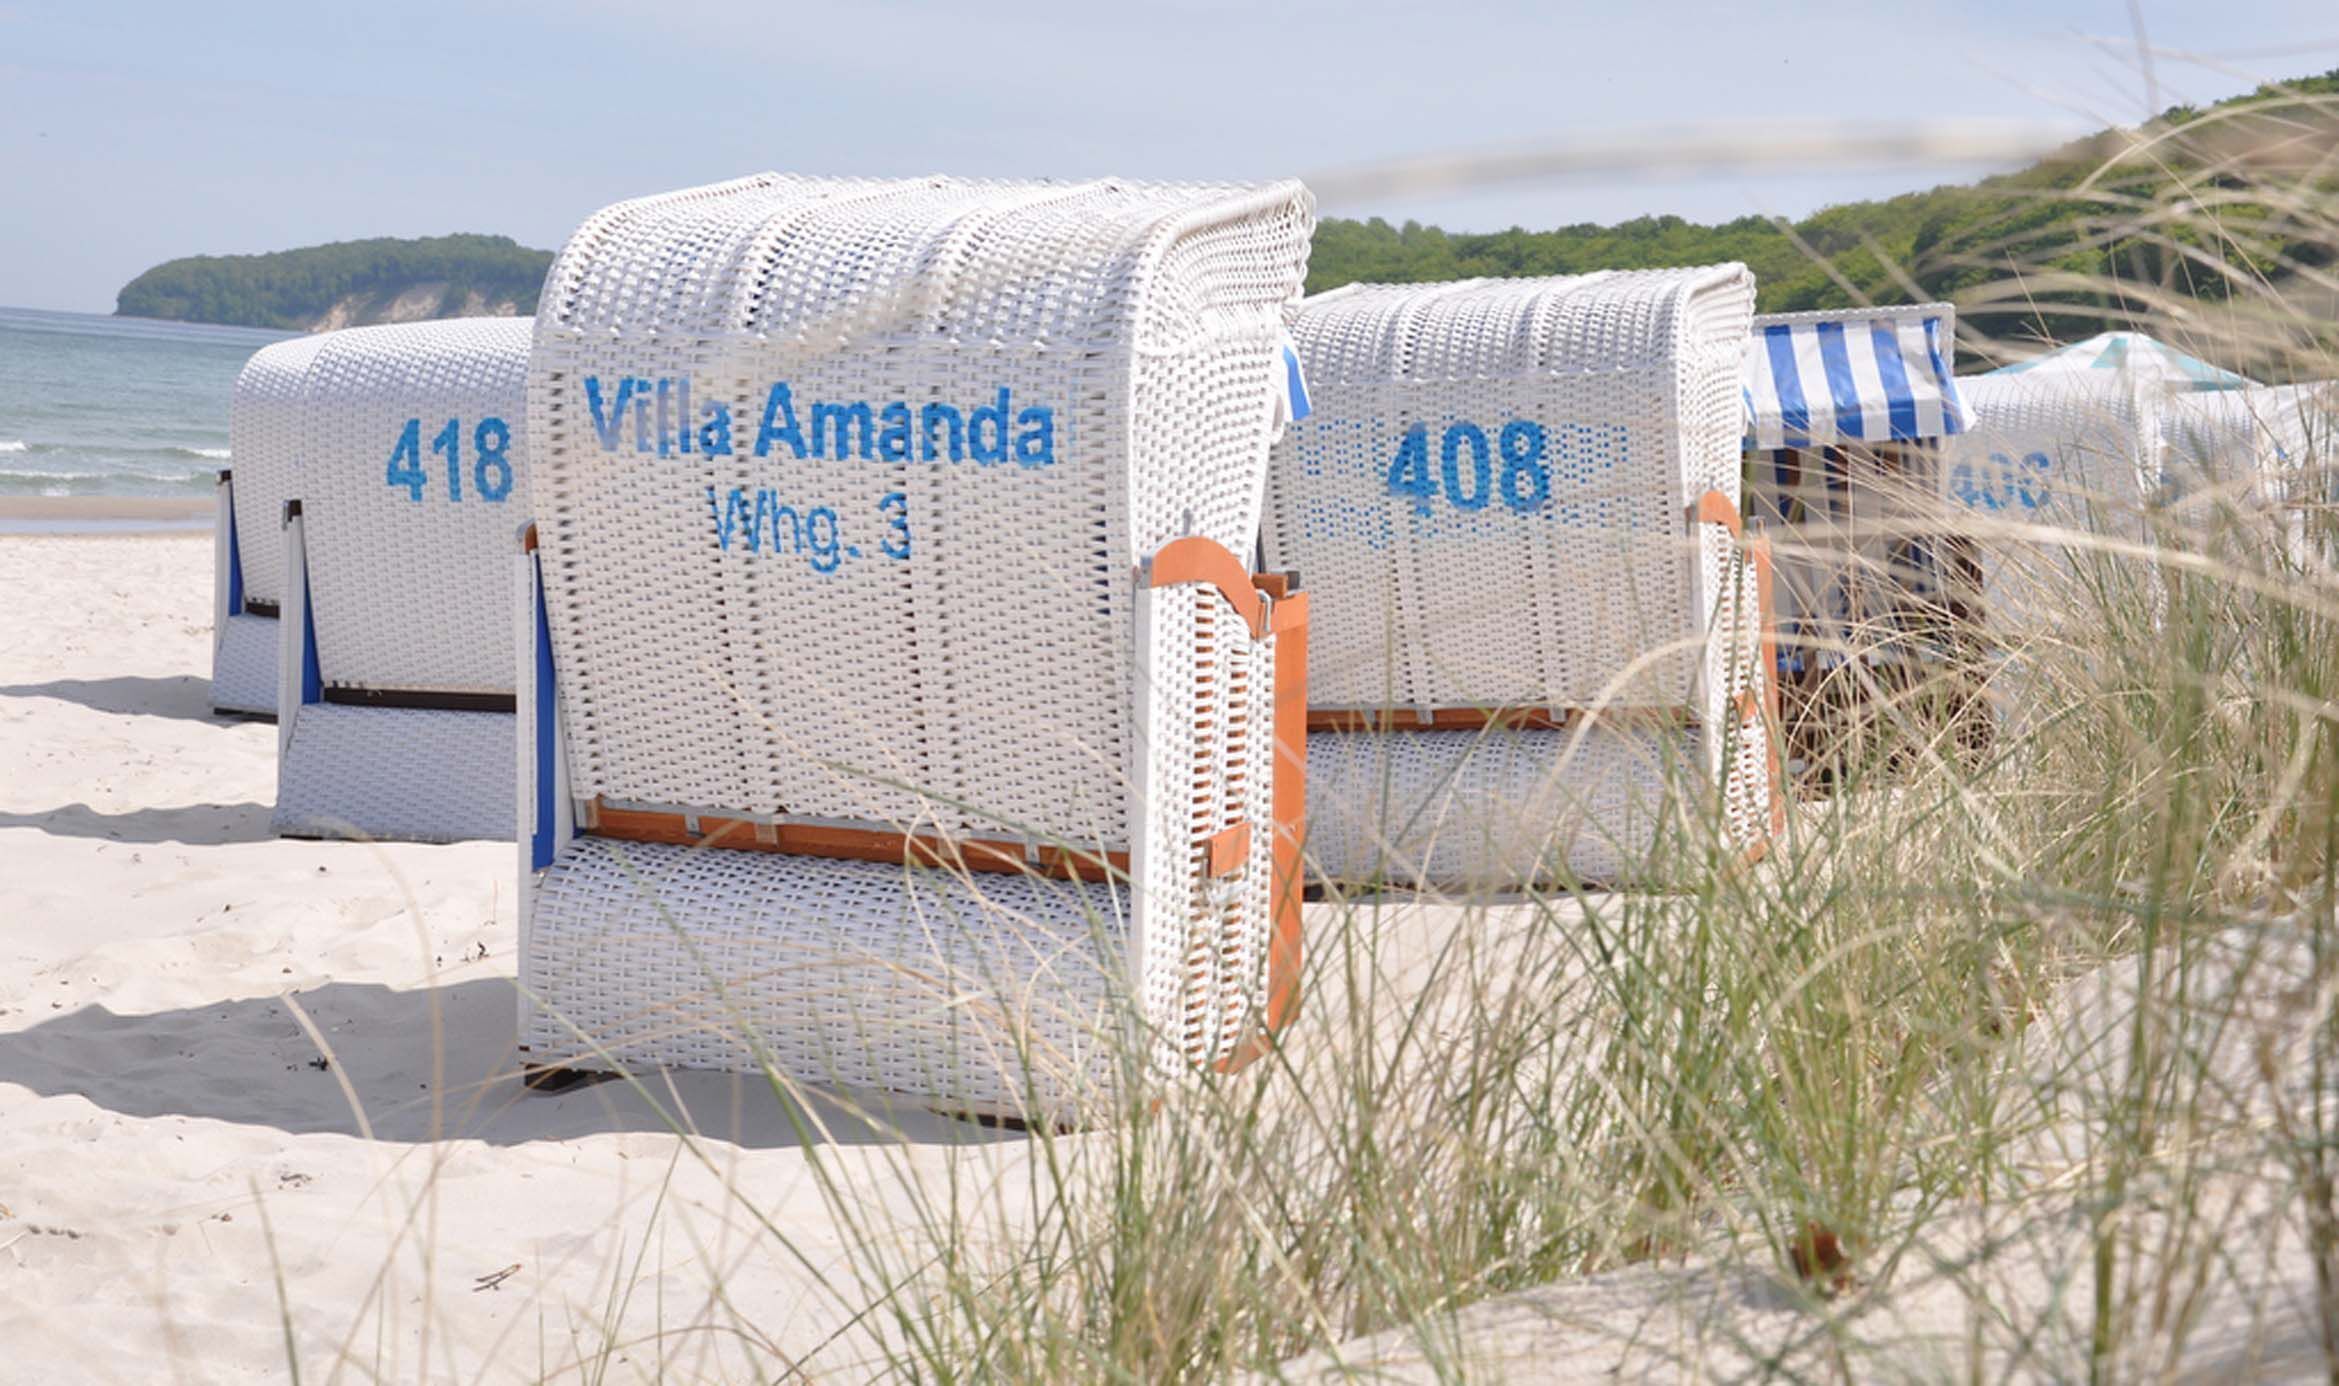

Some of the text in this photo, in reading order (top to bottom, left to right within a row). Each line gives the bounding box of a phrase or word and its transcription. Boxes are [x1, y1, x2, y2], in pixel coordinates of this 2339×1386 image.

[386, 416, 513, 502] 418
[584, 375, 1054, 468] Villa Amanda
[1387, 419, 1551, 517] 408
[706, 487, 912, 575] Whg. 3
